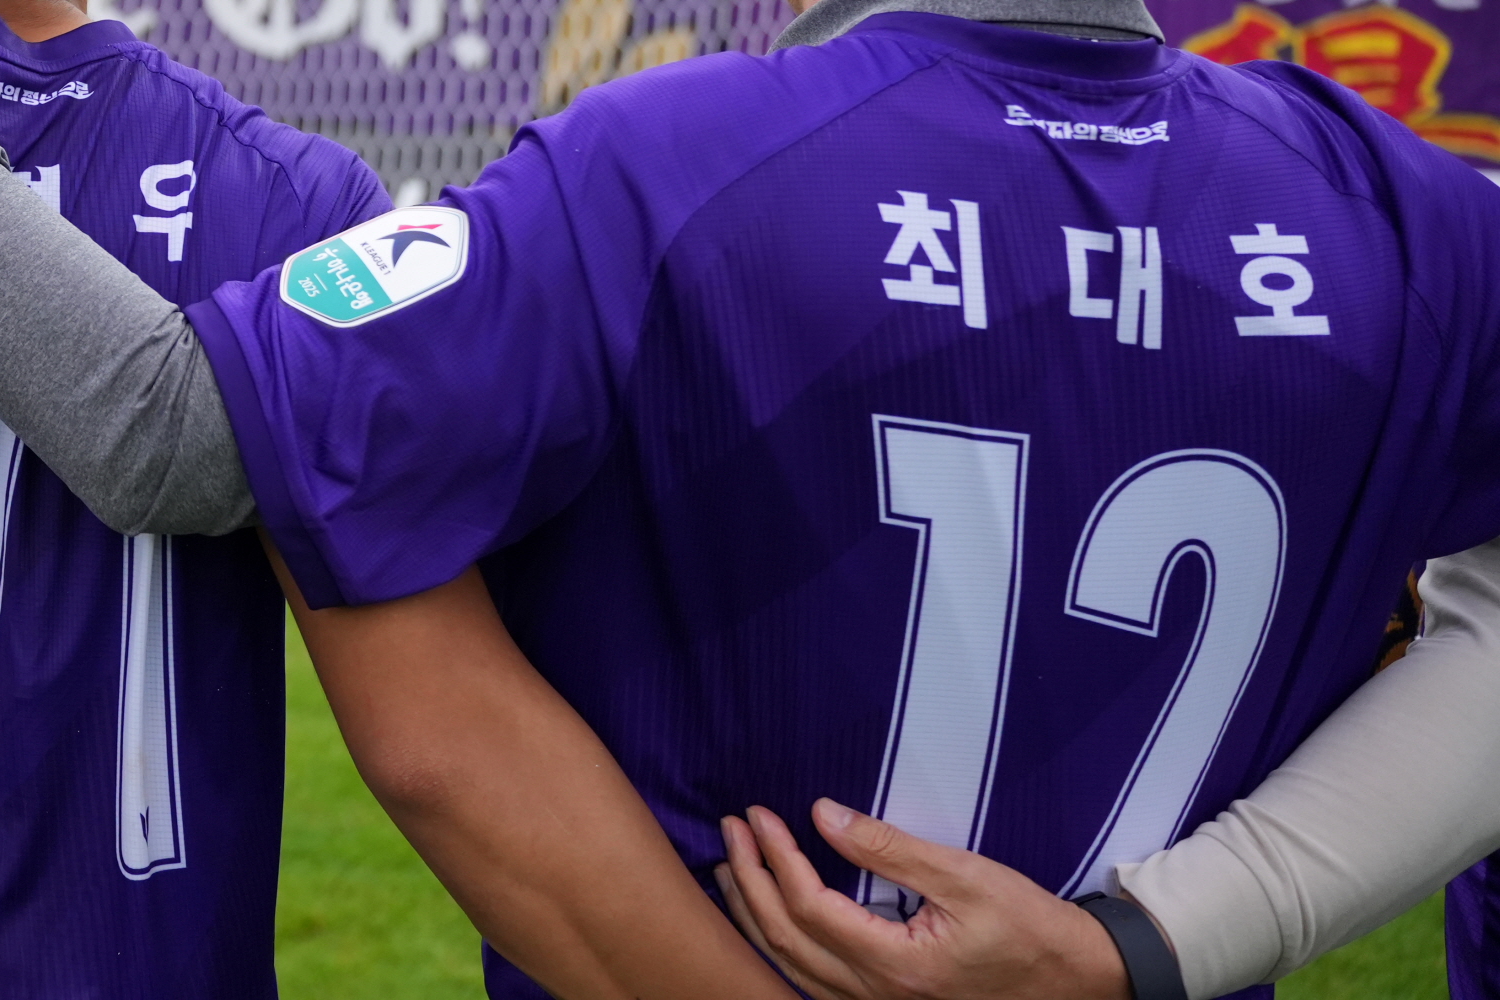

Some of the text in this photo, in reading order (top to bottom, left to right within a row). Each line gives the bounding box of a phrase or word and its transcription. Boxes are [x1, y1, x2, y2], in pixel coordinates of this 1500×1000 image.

[364, 246, 388, 271] LEAGUE
[298, 277, 321, 297] 2025
[856, 413, 1288, 912] 12
